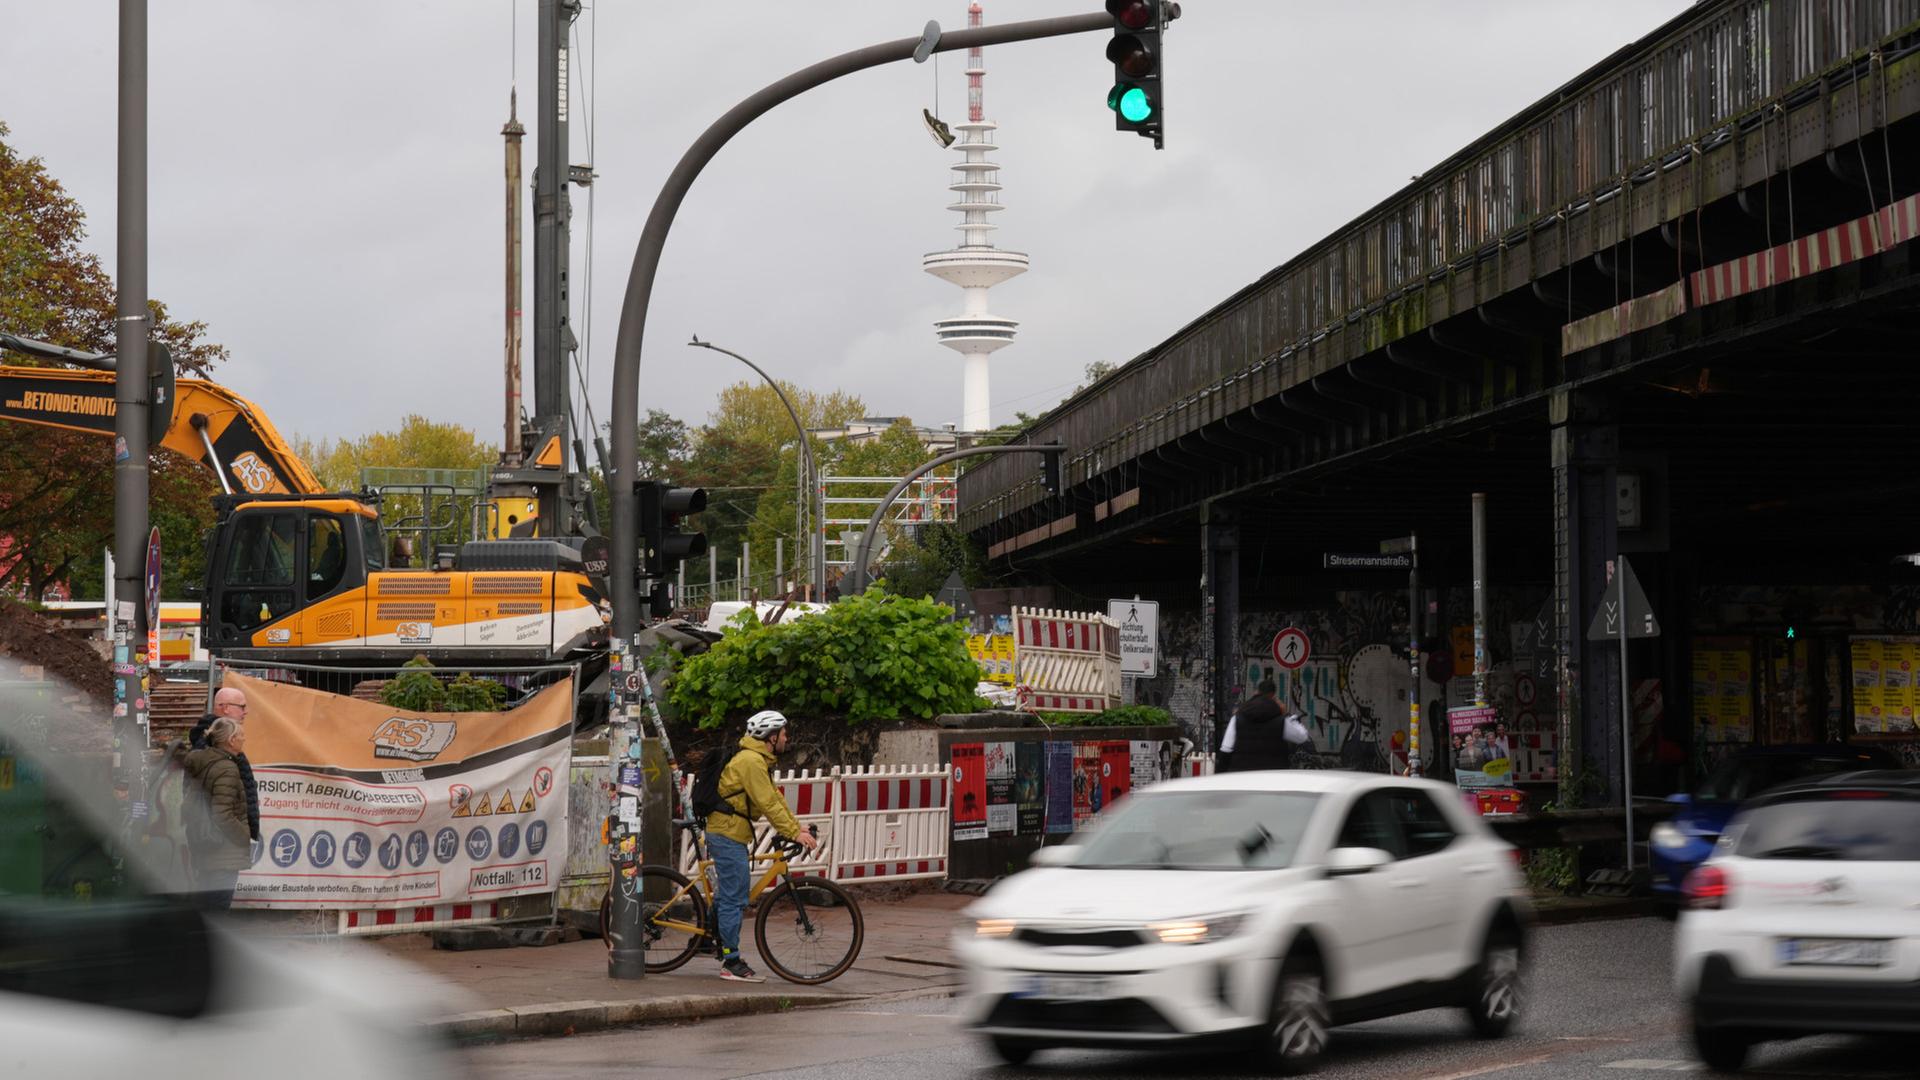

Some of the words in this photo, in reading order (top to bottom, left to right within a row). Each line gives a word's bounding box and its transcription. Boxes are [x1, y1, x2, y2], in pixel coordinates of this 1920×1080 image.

[558, 48, 568, 122] LIEBHERR
[585, 560, 607, 572] USP
[1330, 554, 1410, 567] Stresemannstraße
[1121, 623, 1144, 634] Richtung
[1119, 634, 1149, 643] chulterblatt
[255, 780, 303, 794] RSICHT
[305, 783, 422, 804] ABBRUCHARBEITEN
[263, 797, 299, 810] Zugang
[301, 799, 315, 809] für
[316, 801, 340, 811] nicht
[474, 870, 515, 887] Notfall:
[521, 867, 542, 882] 112
[268, 883, 281, 892] der
[282, 883, 316, 893] Baustelle
[316, 884, 350, 894] verboten.
[351, 885, 372, 894] Eltern
